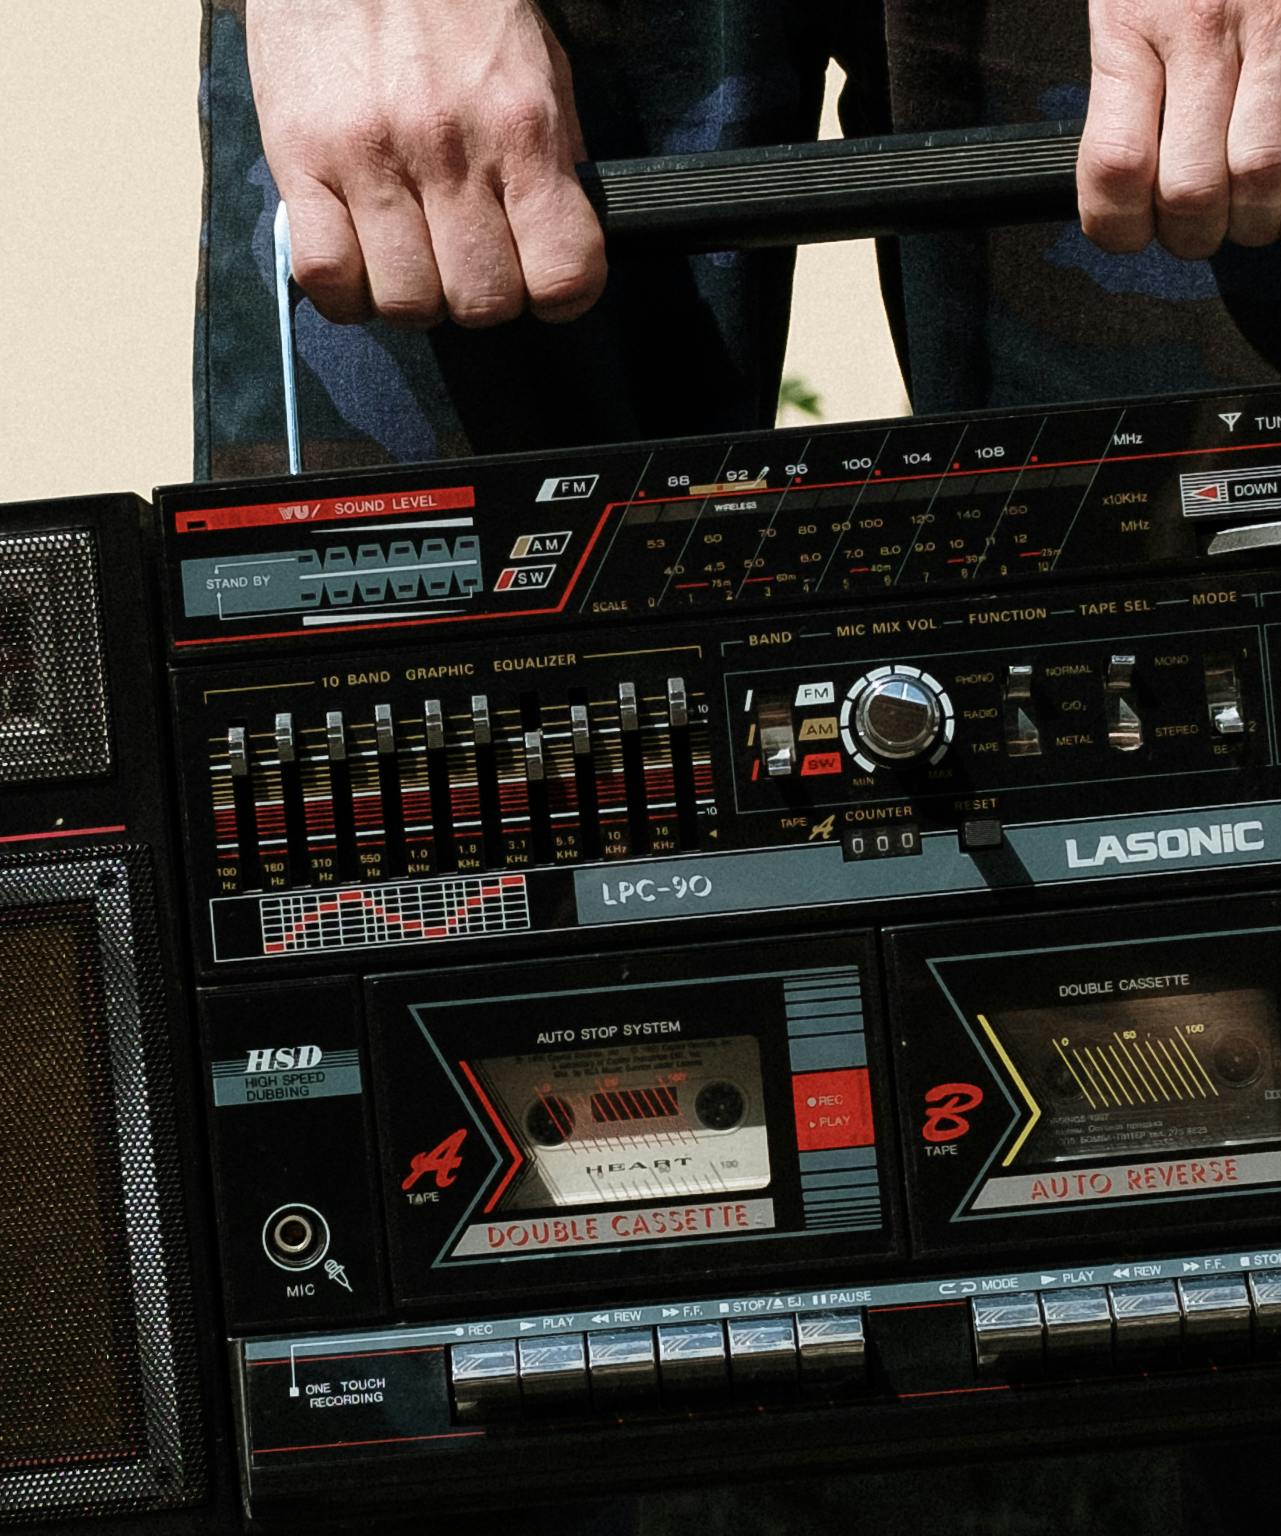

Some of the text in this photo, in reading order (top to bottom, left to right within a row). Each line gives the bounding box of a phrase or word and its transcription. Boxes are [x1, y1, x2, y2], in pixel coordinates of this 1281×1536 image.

[667, 433, 1144, 487] 88 92 96 100 104 108 MHz
[561, 481, 587, 494] FM
[1234, 481, 1277, 497] DOWN
[334, 500, 385, 515] SOUND
[392, 495, 437, 510] LEVEL
[714, 501, 757, 512] WIRELESS
[646, 509, 981, 549] 53 60 70 90 100 120 140
[532, 537, 558, 552] AM
[704, 519, 1151, 572] 4.5 7.0 10 12 MHz
[206, 574, 271, 590] STAND BY
[517, 571, 545, 585] SW
[1192, 591, 1237, 606] MODE
[592, 600, 628, 613] SCALE
[1079, 602, 1117, 616] TAPE
[969, 608, 1047, 624] FUNCTION
[836, 624, 866, 637] MIC
[872, 621, 901, 634] MIX
[748, 631, 792, 646] BAND
[1154, 655, 1189, 667] MONO
[321, 653, 577, 688] 10 BAND GRAPHIC EQUALIZER
[1045, 665, 1093, 677] NORMAL
[804, 687, 829, 699] FM
[963, 708, 998, 719] RADIO
[806, 723, 833, 735] AM
[1155, 724, 1199, 737] STEREO
[1248, 721, 1256, 732] 2
[1056, 734, 1095, 747] METAL
[970, 743, 1000, 754] TAPE
[808, 757, 836, 770] SW
[852, 775, 875, 786] MIN
[781, 817, 807, 828] TAPE
[845, 806, 913, 822] COUNTER
[311, 858, 332, 869] 310
[410, 849, 428, 859] 1.0
[507, 839, 527, 850] 3.1
[607, 831, 621, 841] 10
[222, 839, 676, 891] Hz Hz Hz Hz KHz KHz KHz KHz KHz KHz
[601, 872, 713, 906] LPC-90
[1059, 973, 1190, 998] DOUBLE CASSETTE
[536, 1020, 681, 1045] AUTO STOP SYSTEM
[246, 1044, 323, 1073] HSD
[245, 1071, 326, 1088] HIGH SPEED
[246, 1086, 310, 1101] DUBBING
[818, 1094, 844, 1107] REC
[819, 1115, 851, 1128] PLAY
[924, 1144, 958, 1157] TAPE
[401, 1128, 468, 1191] A
[1031, 1159, 1238, 1200] AUTO REVERSE
[406, 1190, 440, 1204] TAPE
[487, 1203, 749, 1249] DOUBLE CASSETTE
[1062, 1271, 1095, 1283] PLAY
[1134, 1265, 1162, 1277] REW
[287, 1284, 315, 1297] MIC
[981, 1277, 1019, 1291] MODE
[830, 1290, 872, 1304] PAUSE
[543, 1316, 575, 1329] PLAY
[613, 1310, 642, 1323] REW
[468, 1325, 494, 1337] REC
[305, 1377, 386, 1396] ONE TOUCH
[309, 1391, 384, 1409] RECORDING
